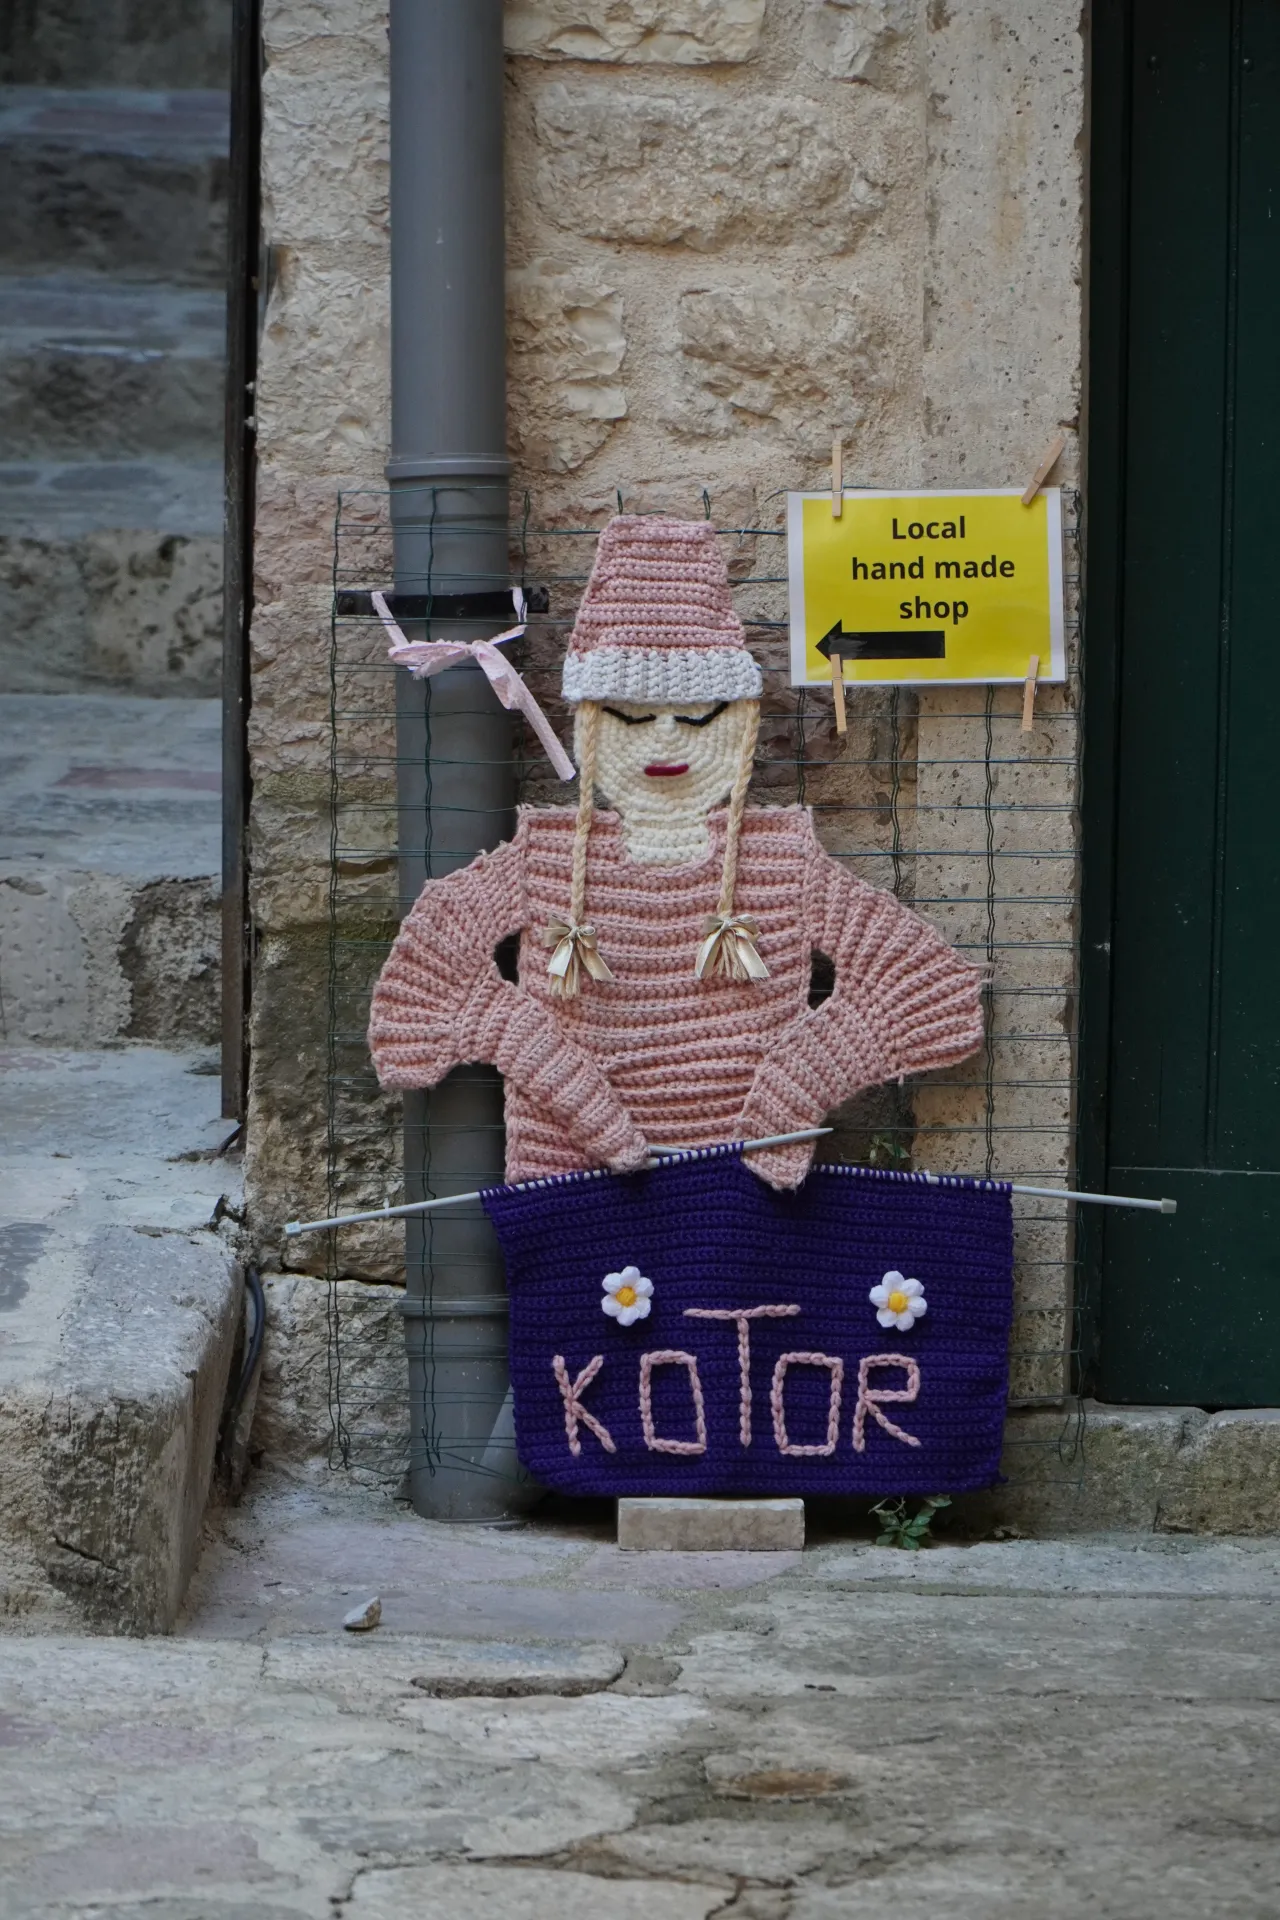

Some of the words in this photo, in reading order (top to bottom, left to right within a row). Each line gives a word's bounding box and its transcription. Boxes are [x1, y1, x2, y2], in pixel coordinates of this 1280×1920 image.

[892, 515, 966, 540] Local
[852, 556, 924, 580] hand
[934, 554, 1015, 579] made
[899, 595, 969, 625] shop
[552, 1304, 922, 1457] KOTOR
